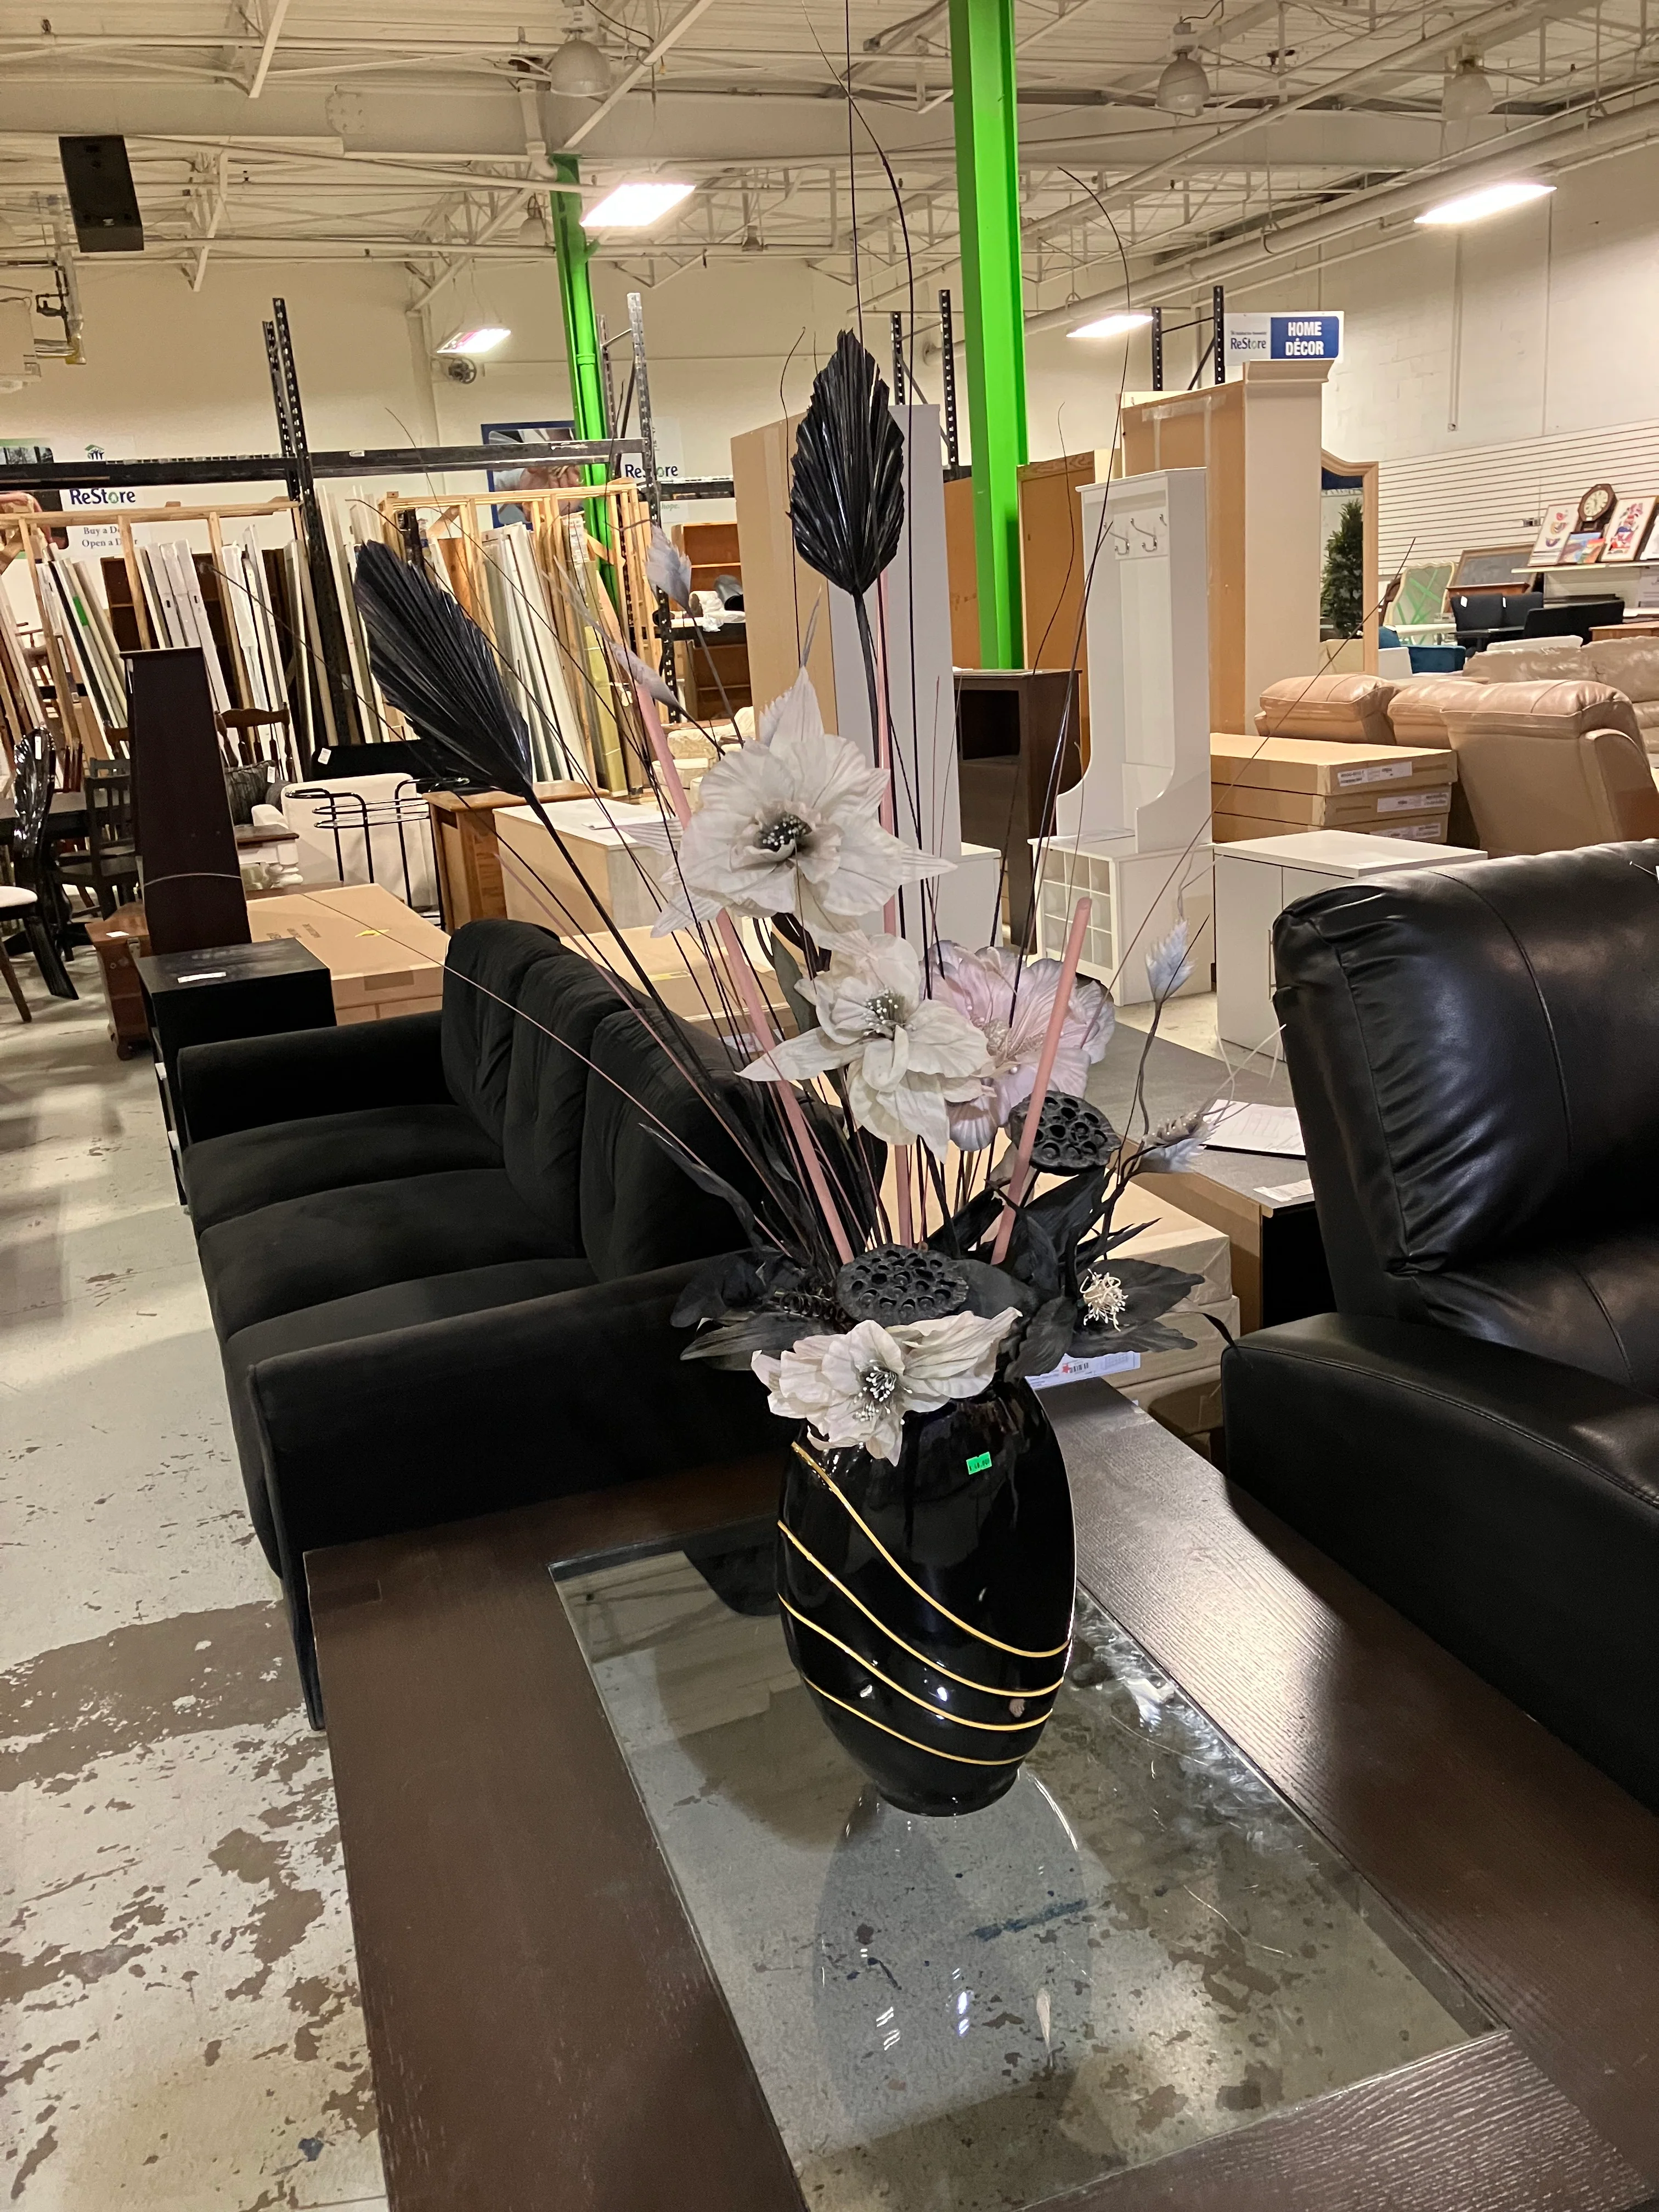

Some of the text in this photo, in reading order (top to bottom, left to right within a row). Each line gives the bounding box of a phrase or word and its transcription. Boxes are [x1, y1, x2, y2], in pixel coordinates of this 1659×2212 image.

[1288, 321, 1322, 336] HOME
[1231, 337, 1266, 349] ReStore
[1285, 338, 1324, 356] DÉCOR
[624, 463, 679, 478] Reore
[69, 488, 136, 505] ReStore
[83, 527, 100, 537] Buy
[82, 539, 106, 549] Open
